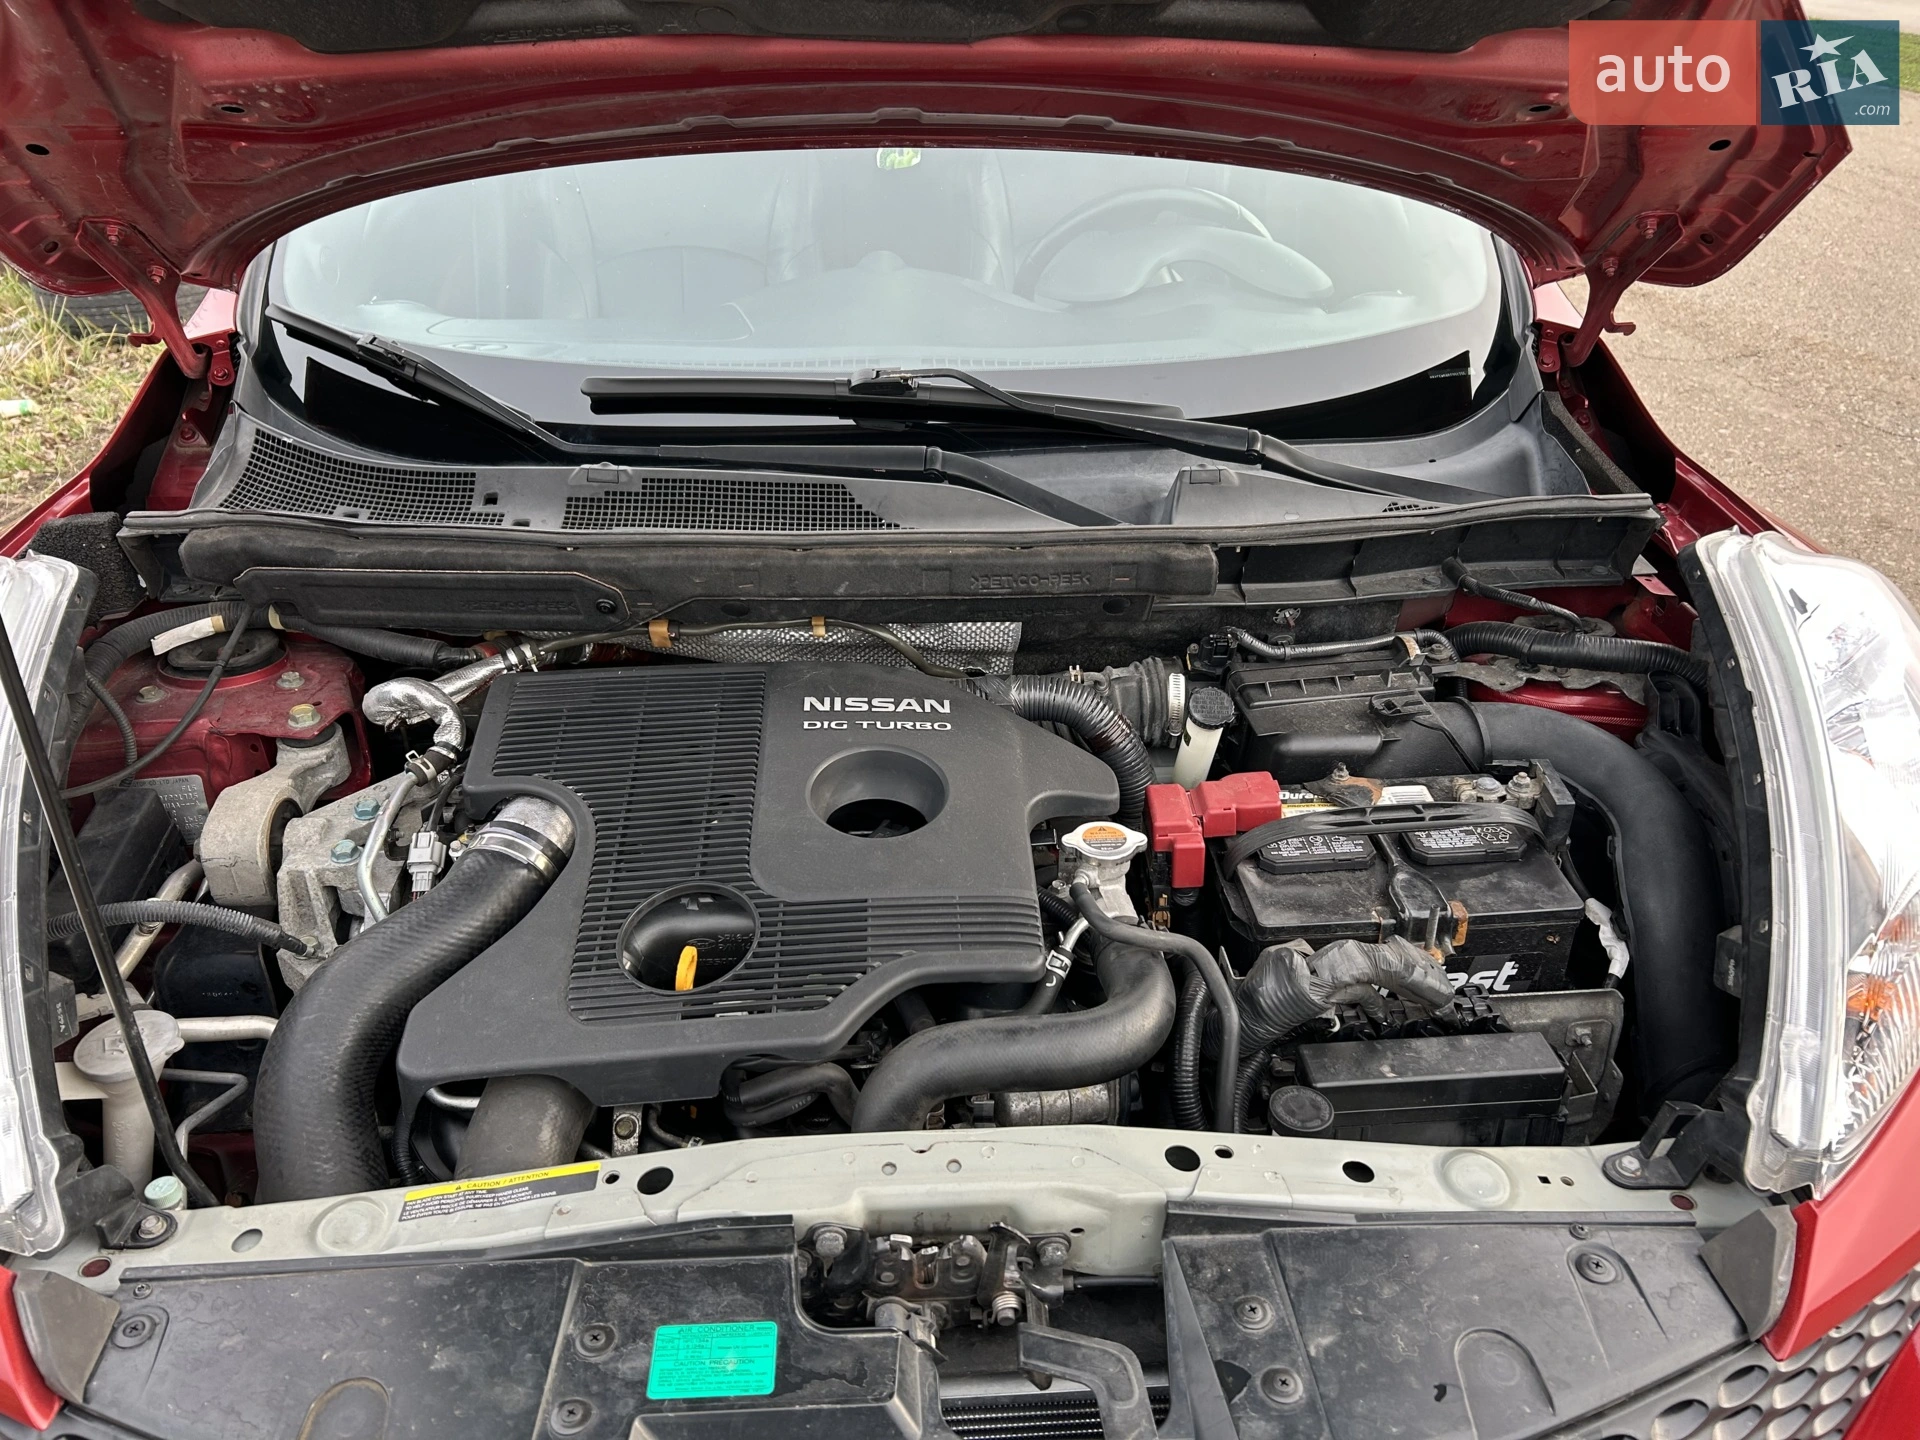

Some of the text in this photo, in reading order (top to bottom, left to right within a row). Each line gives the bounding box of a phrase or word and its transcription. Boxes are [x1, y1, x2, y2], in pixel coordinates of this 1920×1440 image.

[803, 696, 951, 714] NISSAN
[803, 720, 952, 731] DIG TURBO
[466, 1181, 501, 1189] CAUTION
[508, 1172, 549, 1183] ATTENTION
[679, 1326, 693, 1334] AIR
[697, 1325, 755, 1333] CONDITIONER
